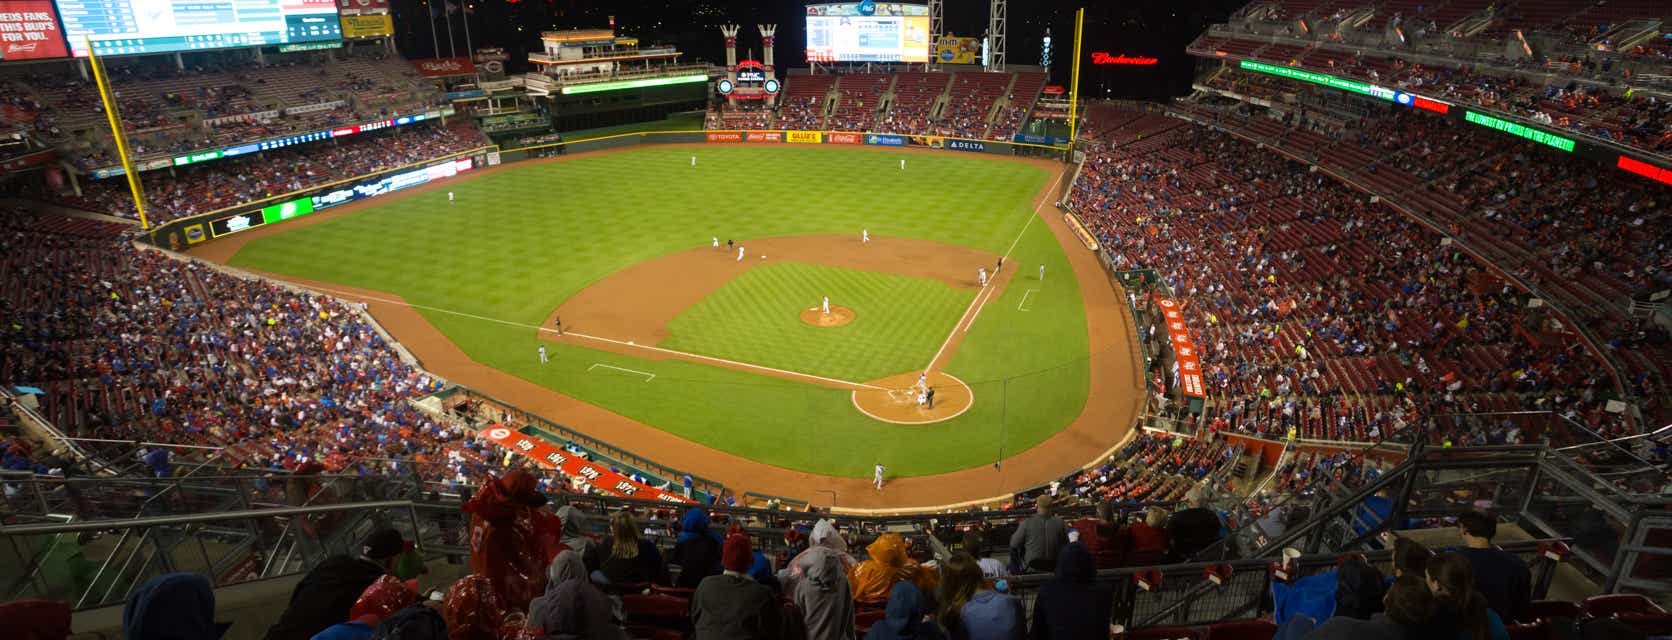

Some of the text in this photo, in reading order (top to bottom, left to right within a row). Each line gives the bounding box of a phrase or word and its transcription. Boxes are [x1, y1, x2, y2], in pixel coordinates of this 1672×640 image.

[0, 22, 23, 32] THIS
[2, 32, 48, 42] FOR YOU.
[1092, 52, 1158, 65] Budweiser
[959, 142, 983, 150] DELTA
